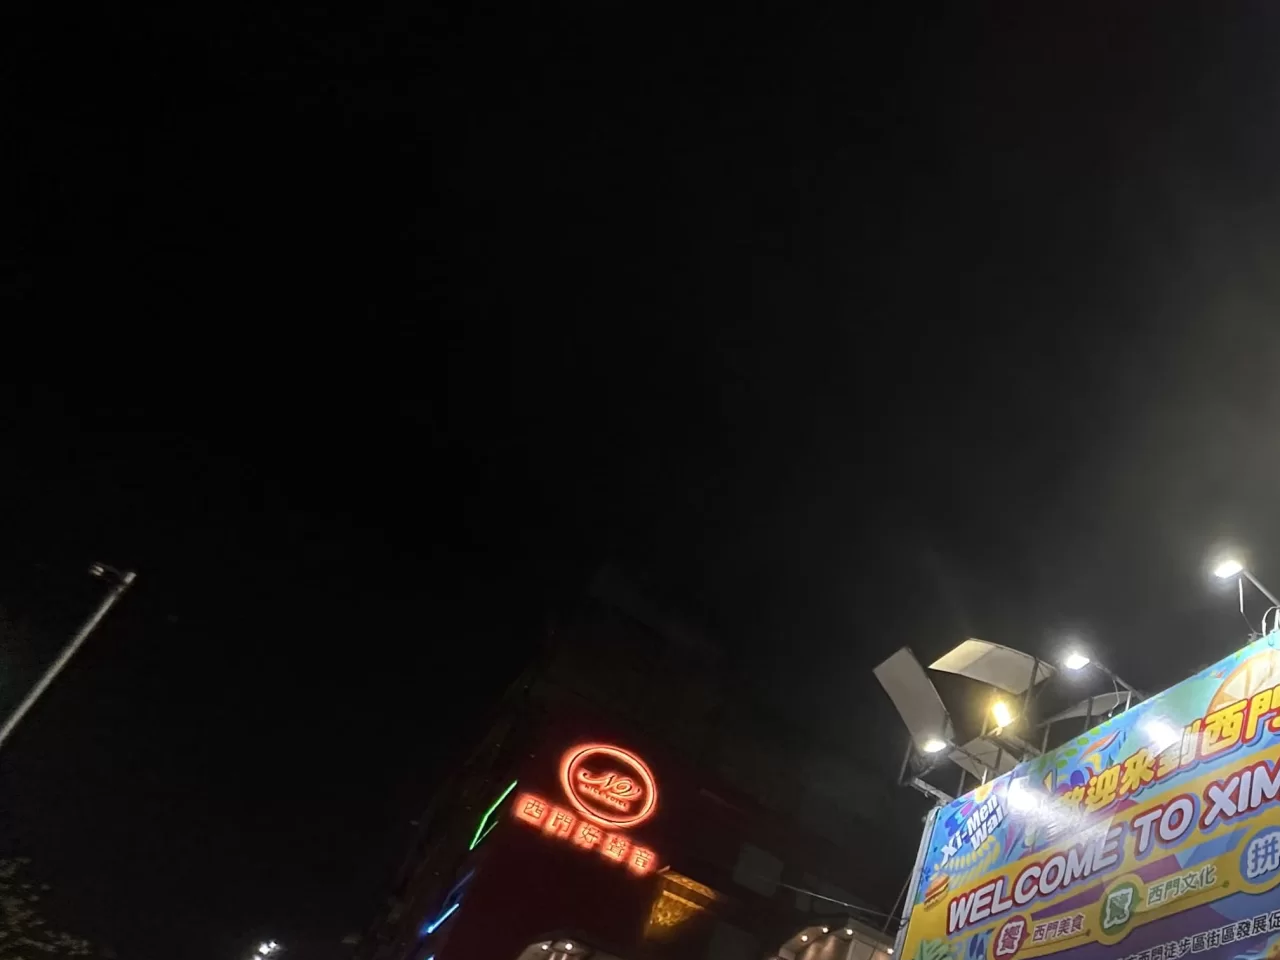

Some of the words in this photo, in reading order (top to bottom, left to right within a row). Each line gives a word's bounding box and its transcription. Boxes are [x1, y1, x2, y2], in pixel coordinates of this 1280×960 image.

[522, 799, 653, 869] 西門好聲音
[940, 794, 999, 867] Xi-Men
[948, 826, 1122, 933] WELCOME
[1133, 798, 1195, 853] TO
[1147, 864, 1217, 906] 西門文化
[1032, 912, 1086, 943] 西門美食
